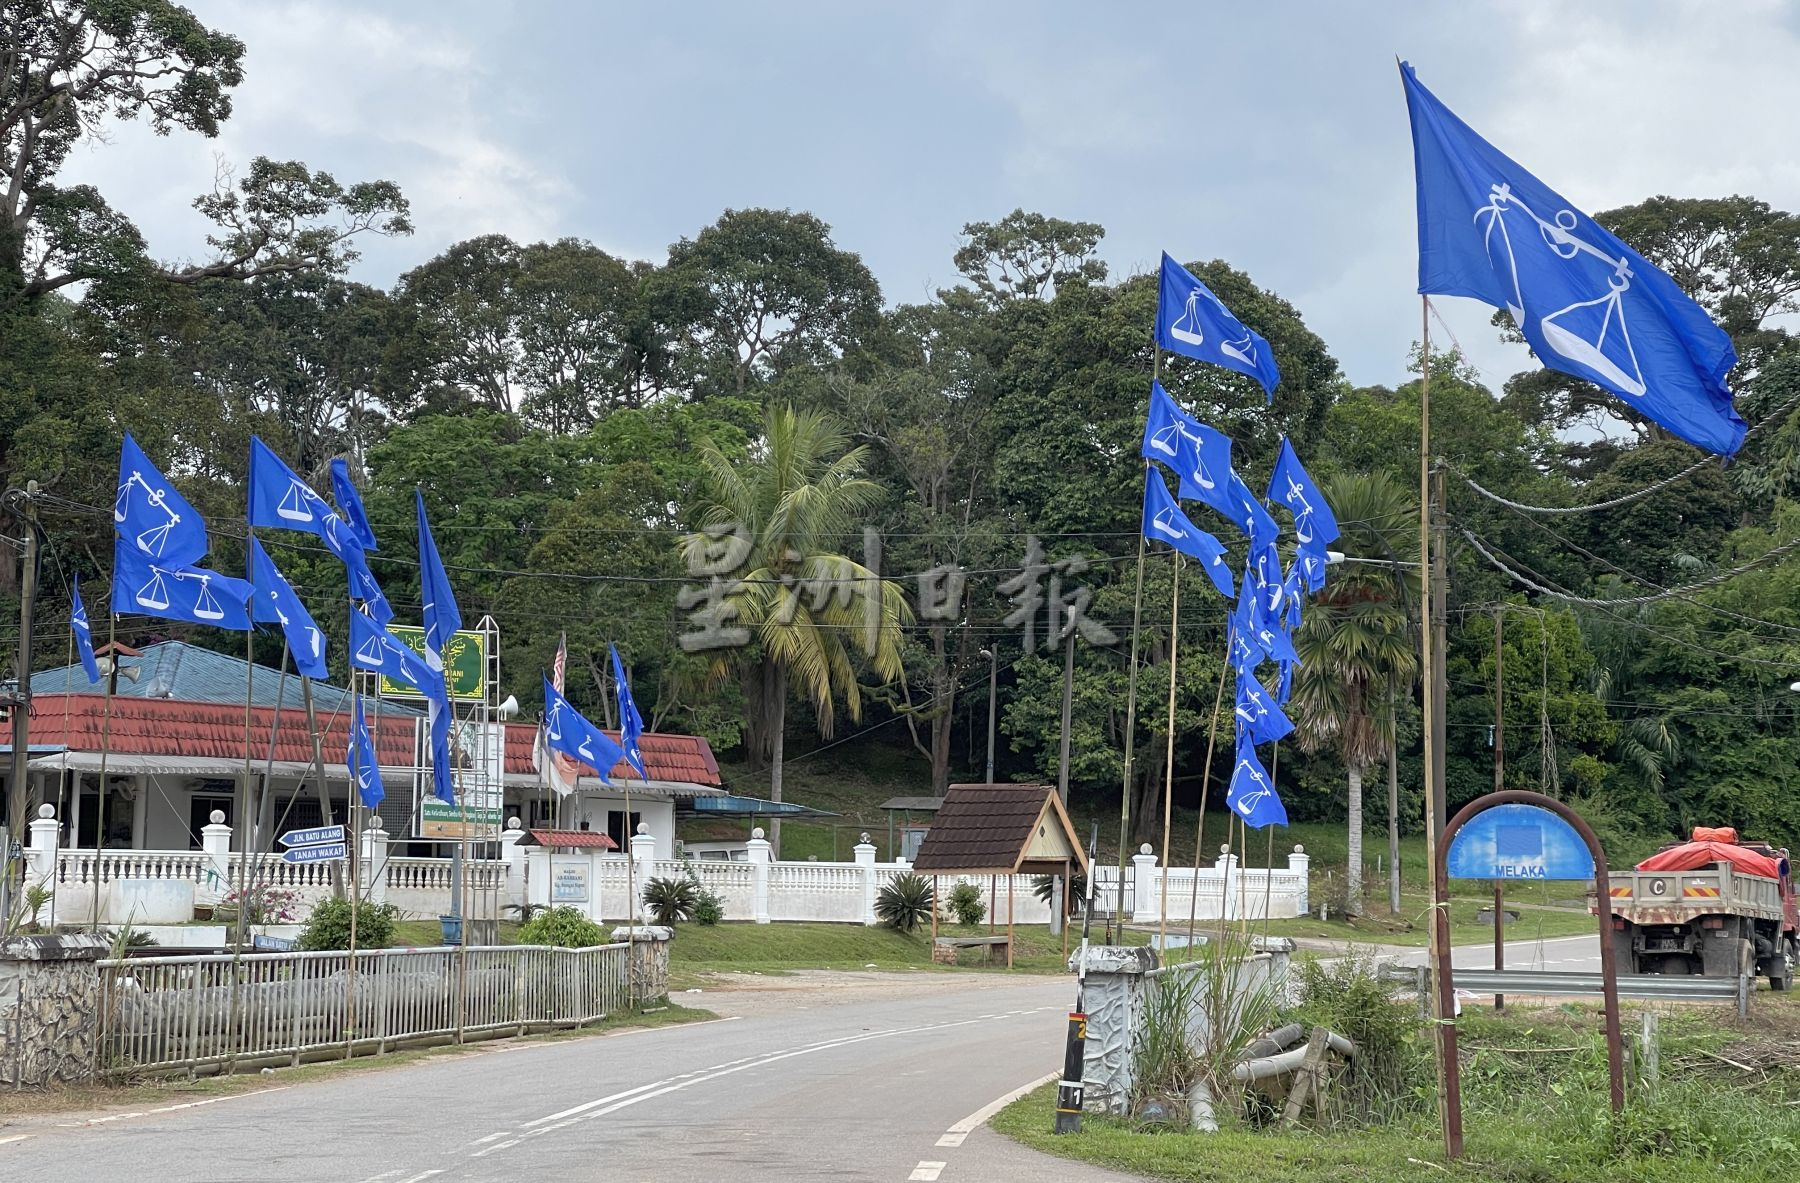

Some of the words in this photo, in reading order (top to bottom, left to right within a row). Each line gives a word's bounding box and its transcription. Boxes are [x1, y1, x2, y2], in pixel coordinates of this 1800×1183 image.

[305, 832, 320, 842] BATU
[320, 829, 341, 839] ALANG
[294, 849, 317, 860] TANAH
[318, 847, 343, 857] WAKAF
[1495, 865, 1546, 877] MELAKA
[1653, 880, 1663, 894] C
[1078, 1023, 1086, 1039] 2
[1073, 1089, 1081, 1105] 1
